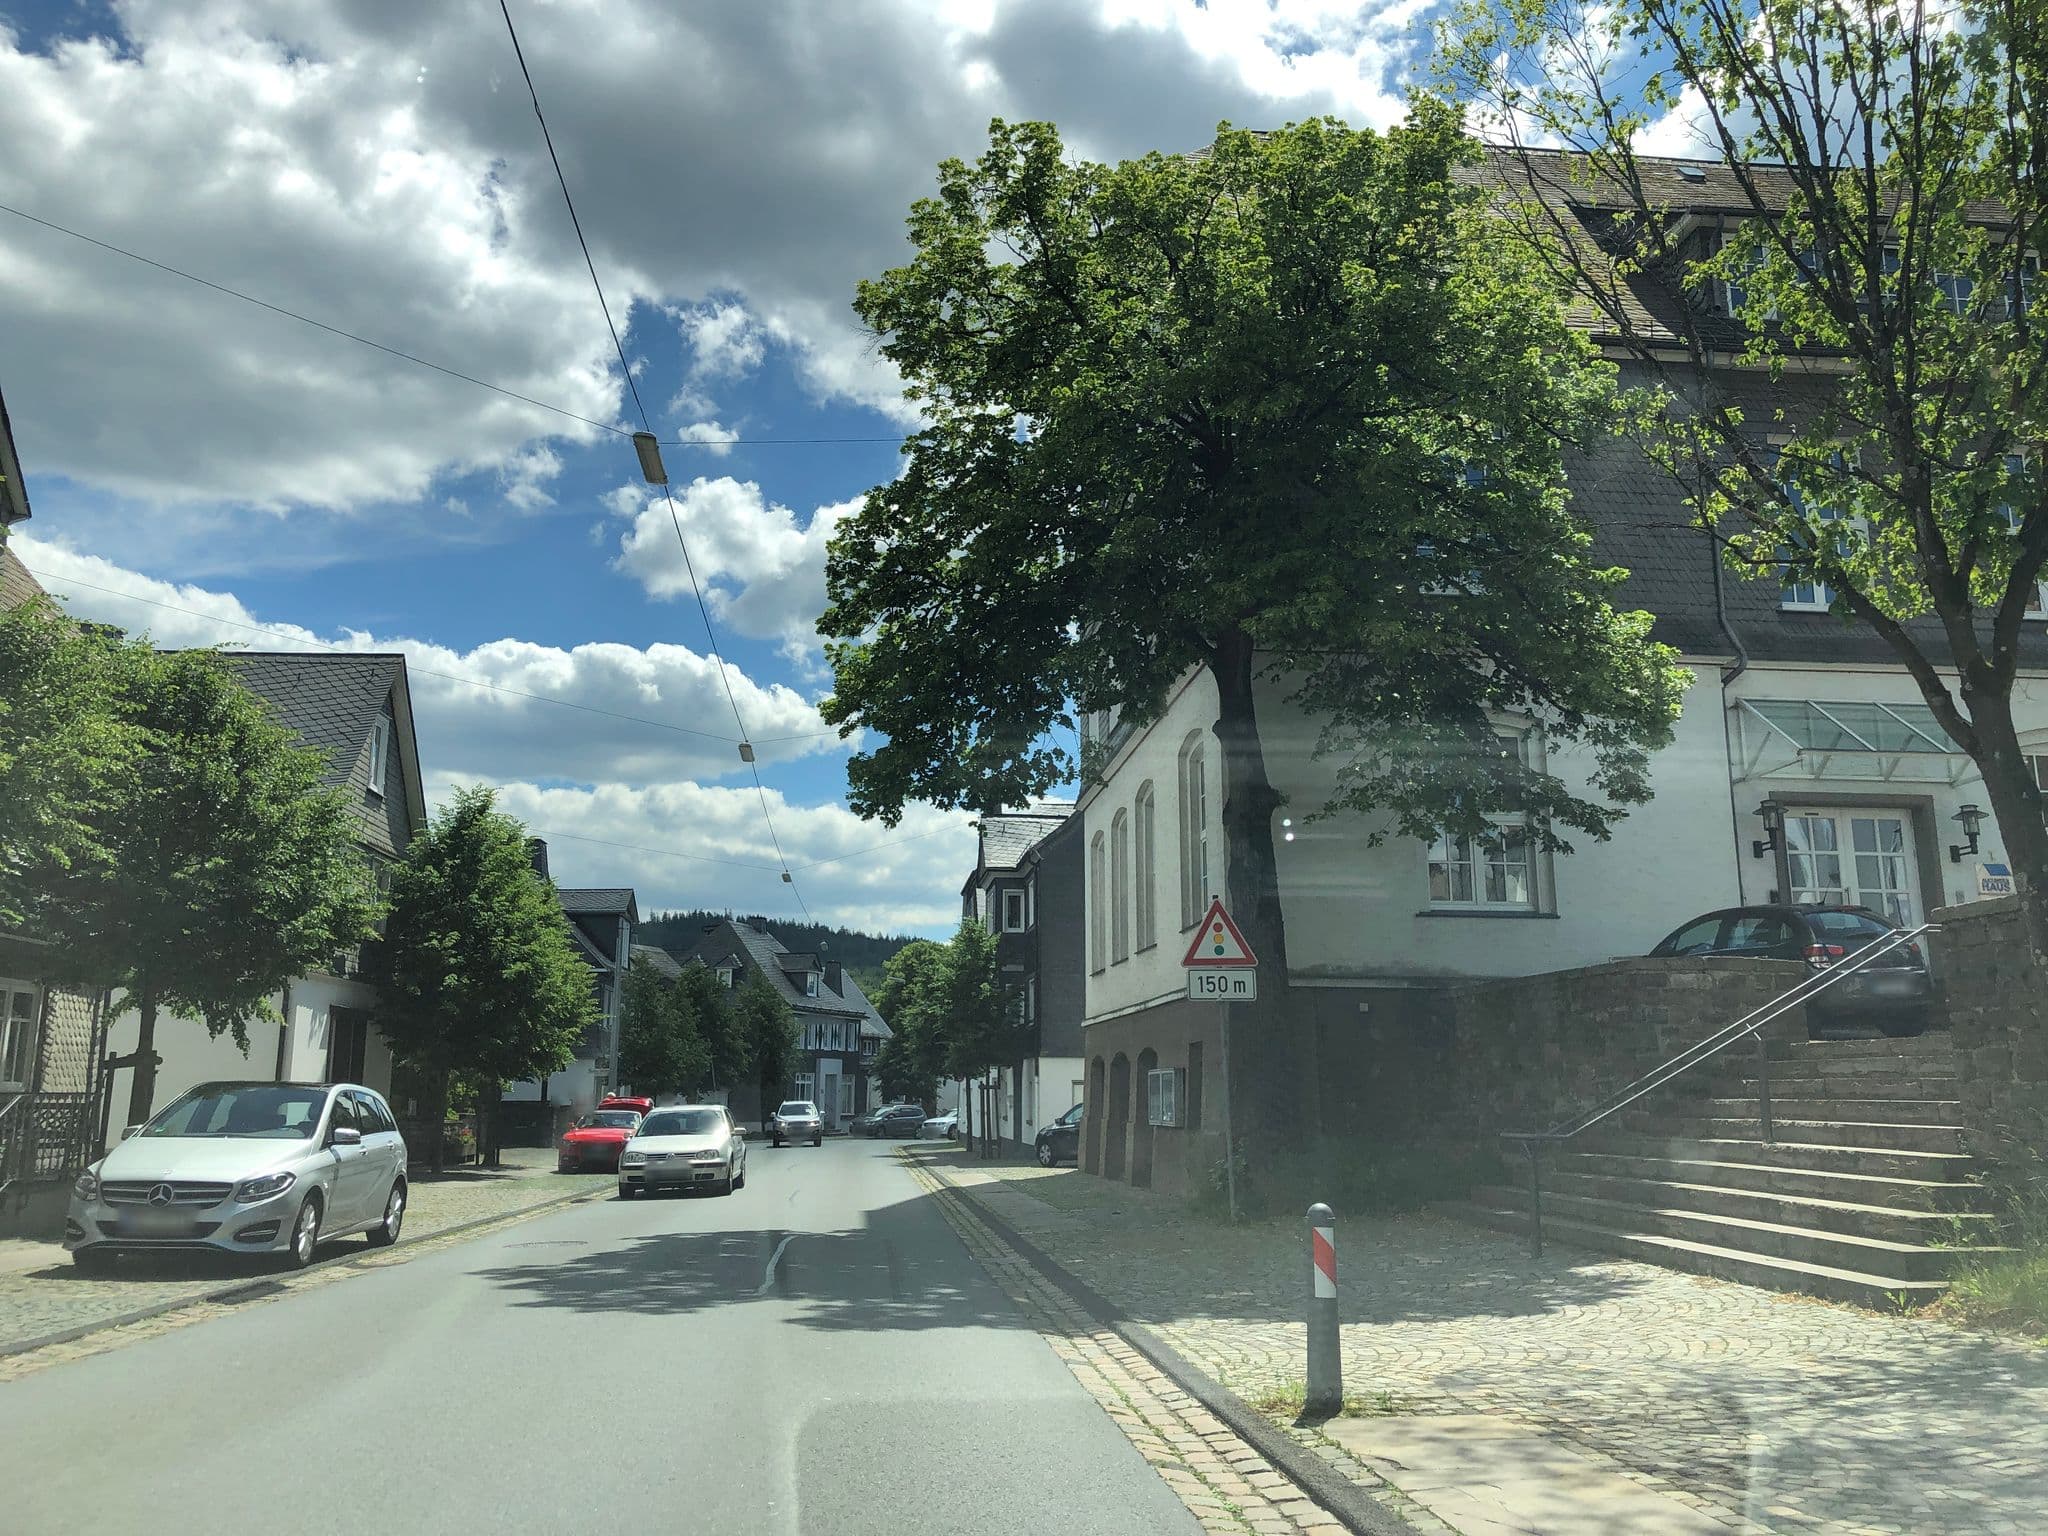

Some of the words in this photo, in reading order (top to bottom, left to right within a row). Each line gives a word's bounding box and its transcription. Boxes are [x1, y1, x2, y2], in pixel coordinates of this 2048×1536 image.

[1982, 882, 2011, 892] HAUS
[1198, 976, 1228, 993] 150
[1234, 981, 1246, 993] m
